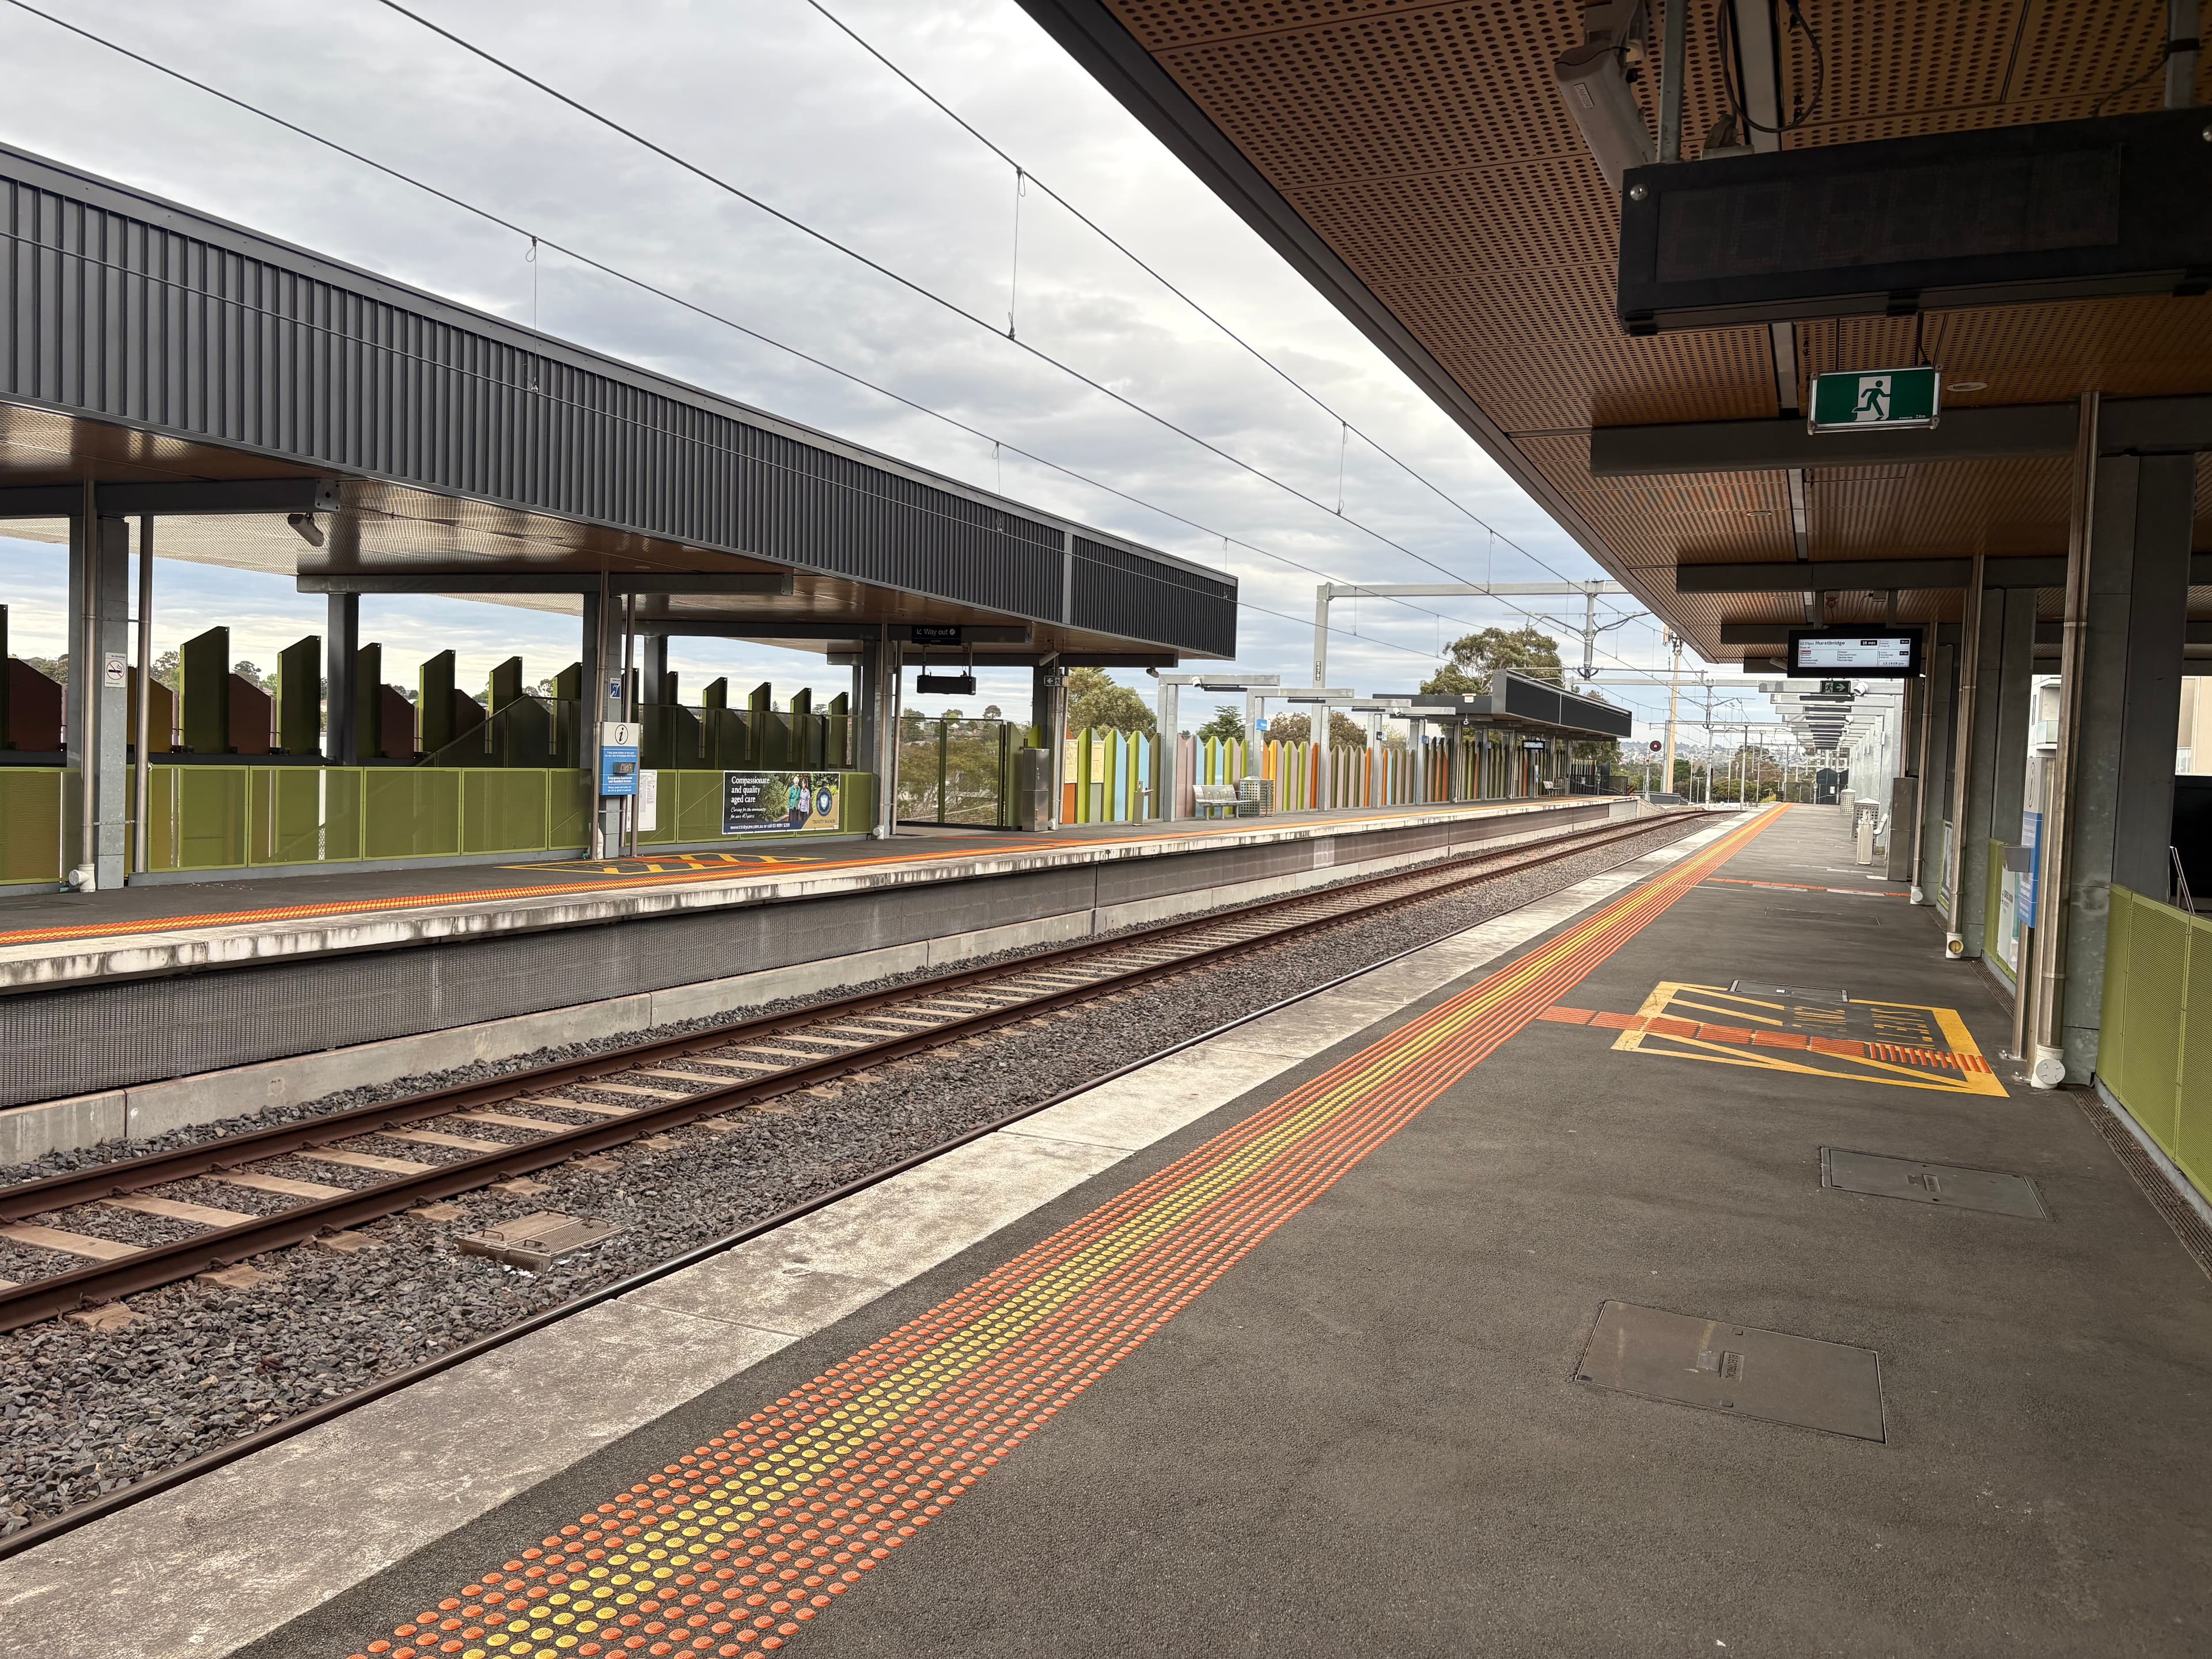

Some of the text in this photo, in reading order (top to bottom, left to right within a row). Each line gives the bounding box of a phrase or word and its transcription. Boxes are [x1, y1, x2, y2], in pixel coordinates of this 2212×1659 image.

[731, 776, 770, 786] Compassionate
[731, 785, 761, 795] and quality
[731, 795, 744, 805] aged
